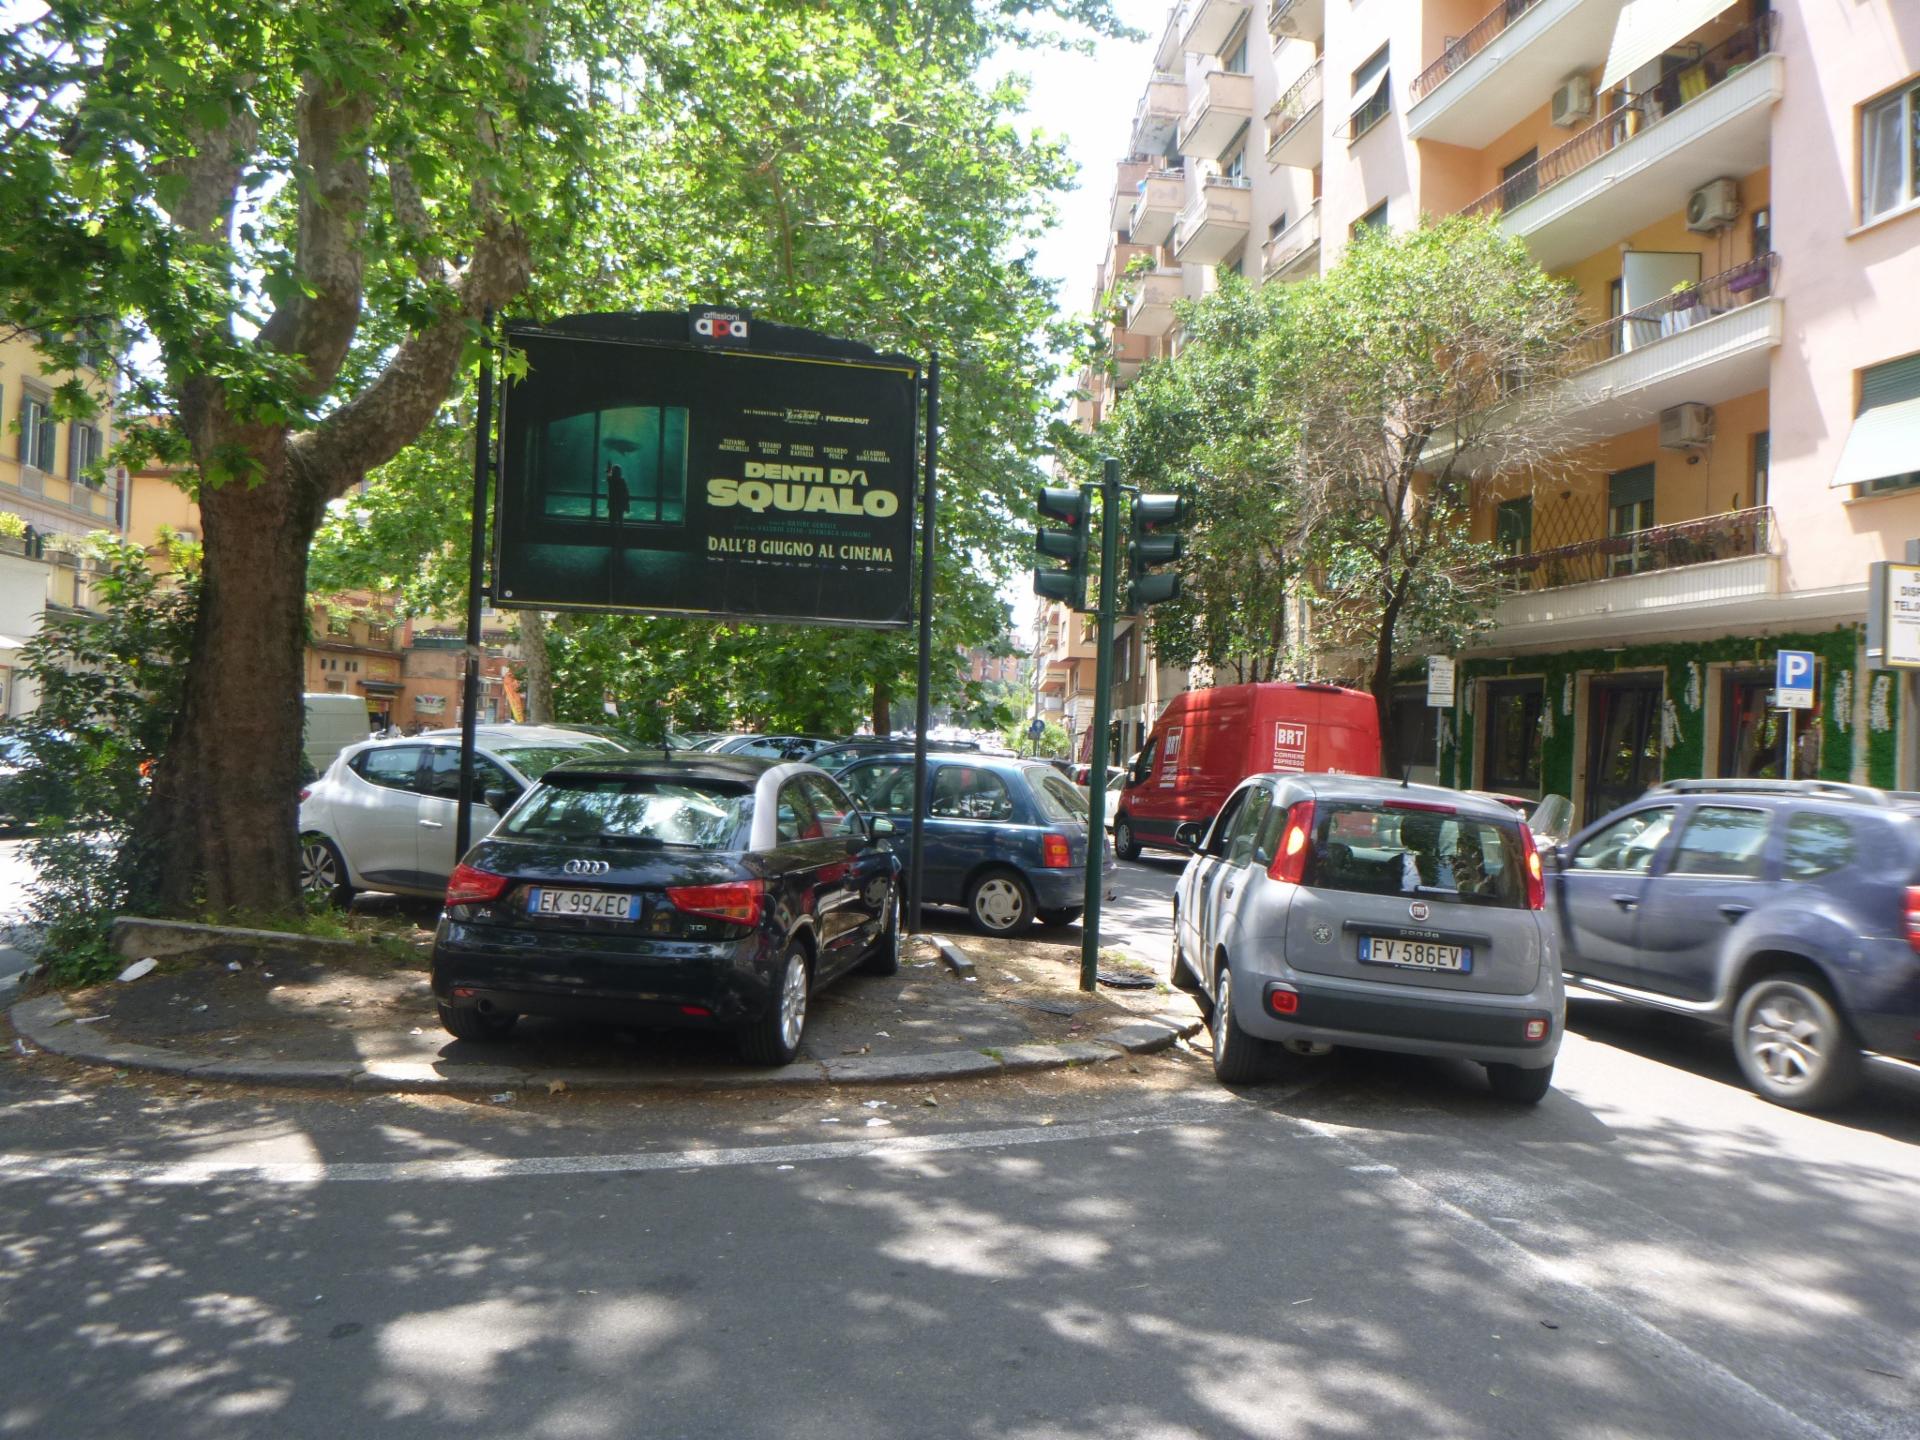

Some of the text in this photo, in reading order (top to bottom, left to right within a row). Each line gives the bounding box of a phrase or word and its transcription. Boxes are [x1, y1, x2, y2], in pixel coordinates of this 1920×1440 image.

[704, 312, 740, 320] affissioni
[696, 319, 748, 338] apa
[744, 461, 868, 486] DENTI DA
[706, 478, 899, 518] SQUALO
[761, 540, 814, 557] GIUGNO
[818, 544, 836, 559] AL
[840, 545, 893, 563] CINEMA
[1785, 655, 1807, 685] P
[1278, 728, 1304, 746] BRT
[541, 891, 628, 916] EK 994EC
[1400, 929, 1440, 939] panda
[1372, 940, 1460, 968] FV 586EV
